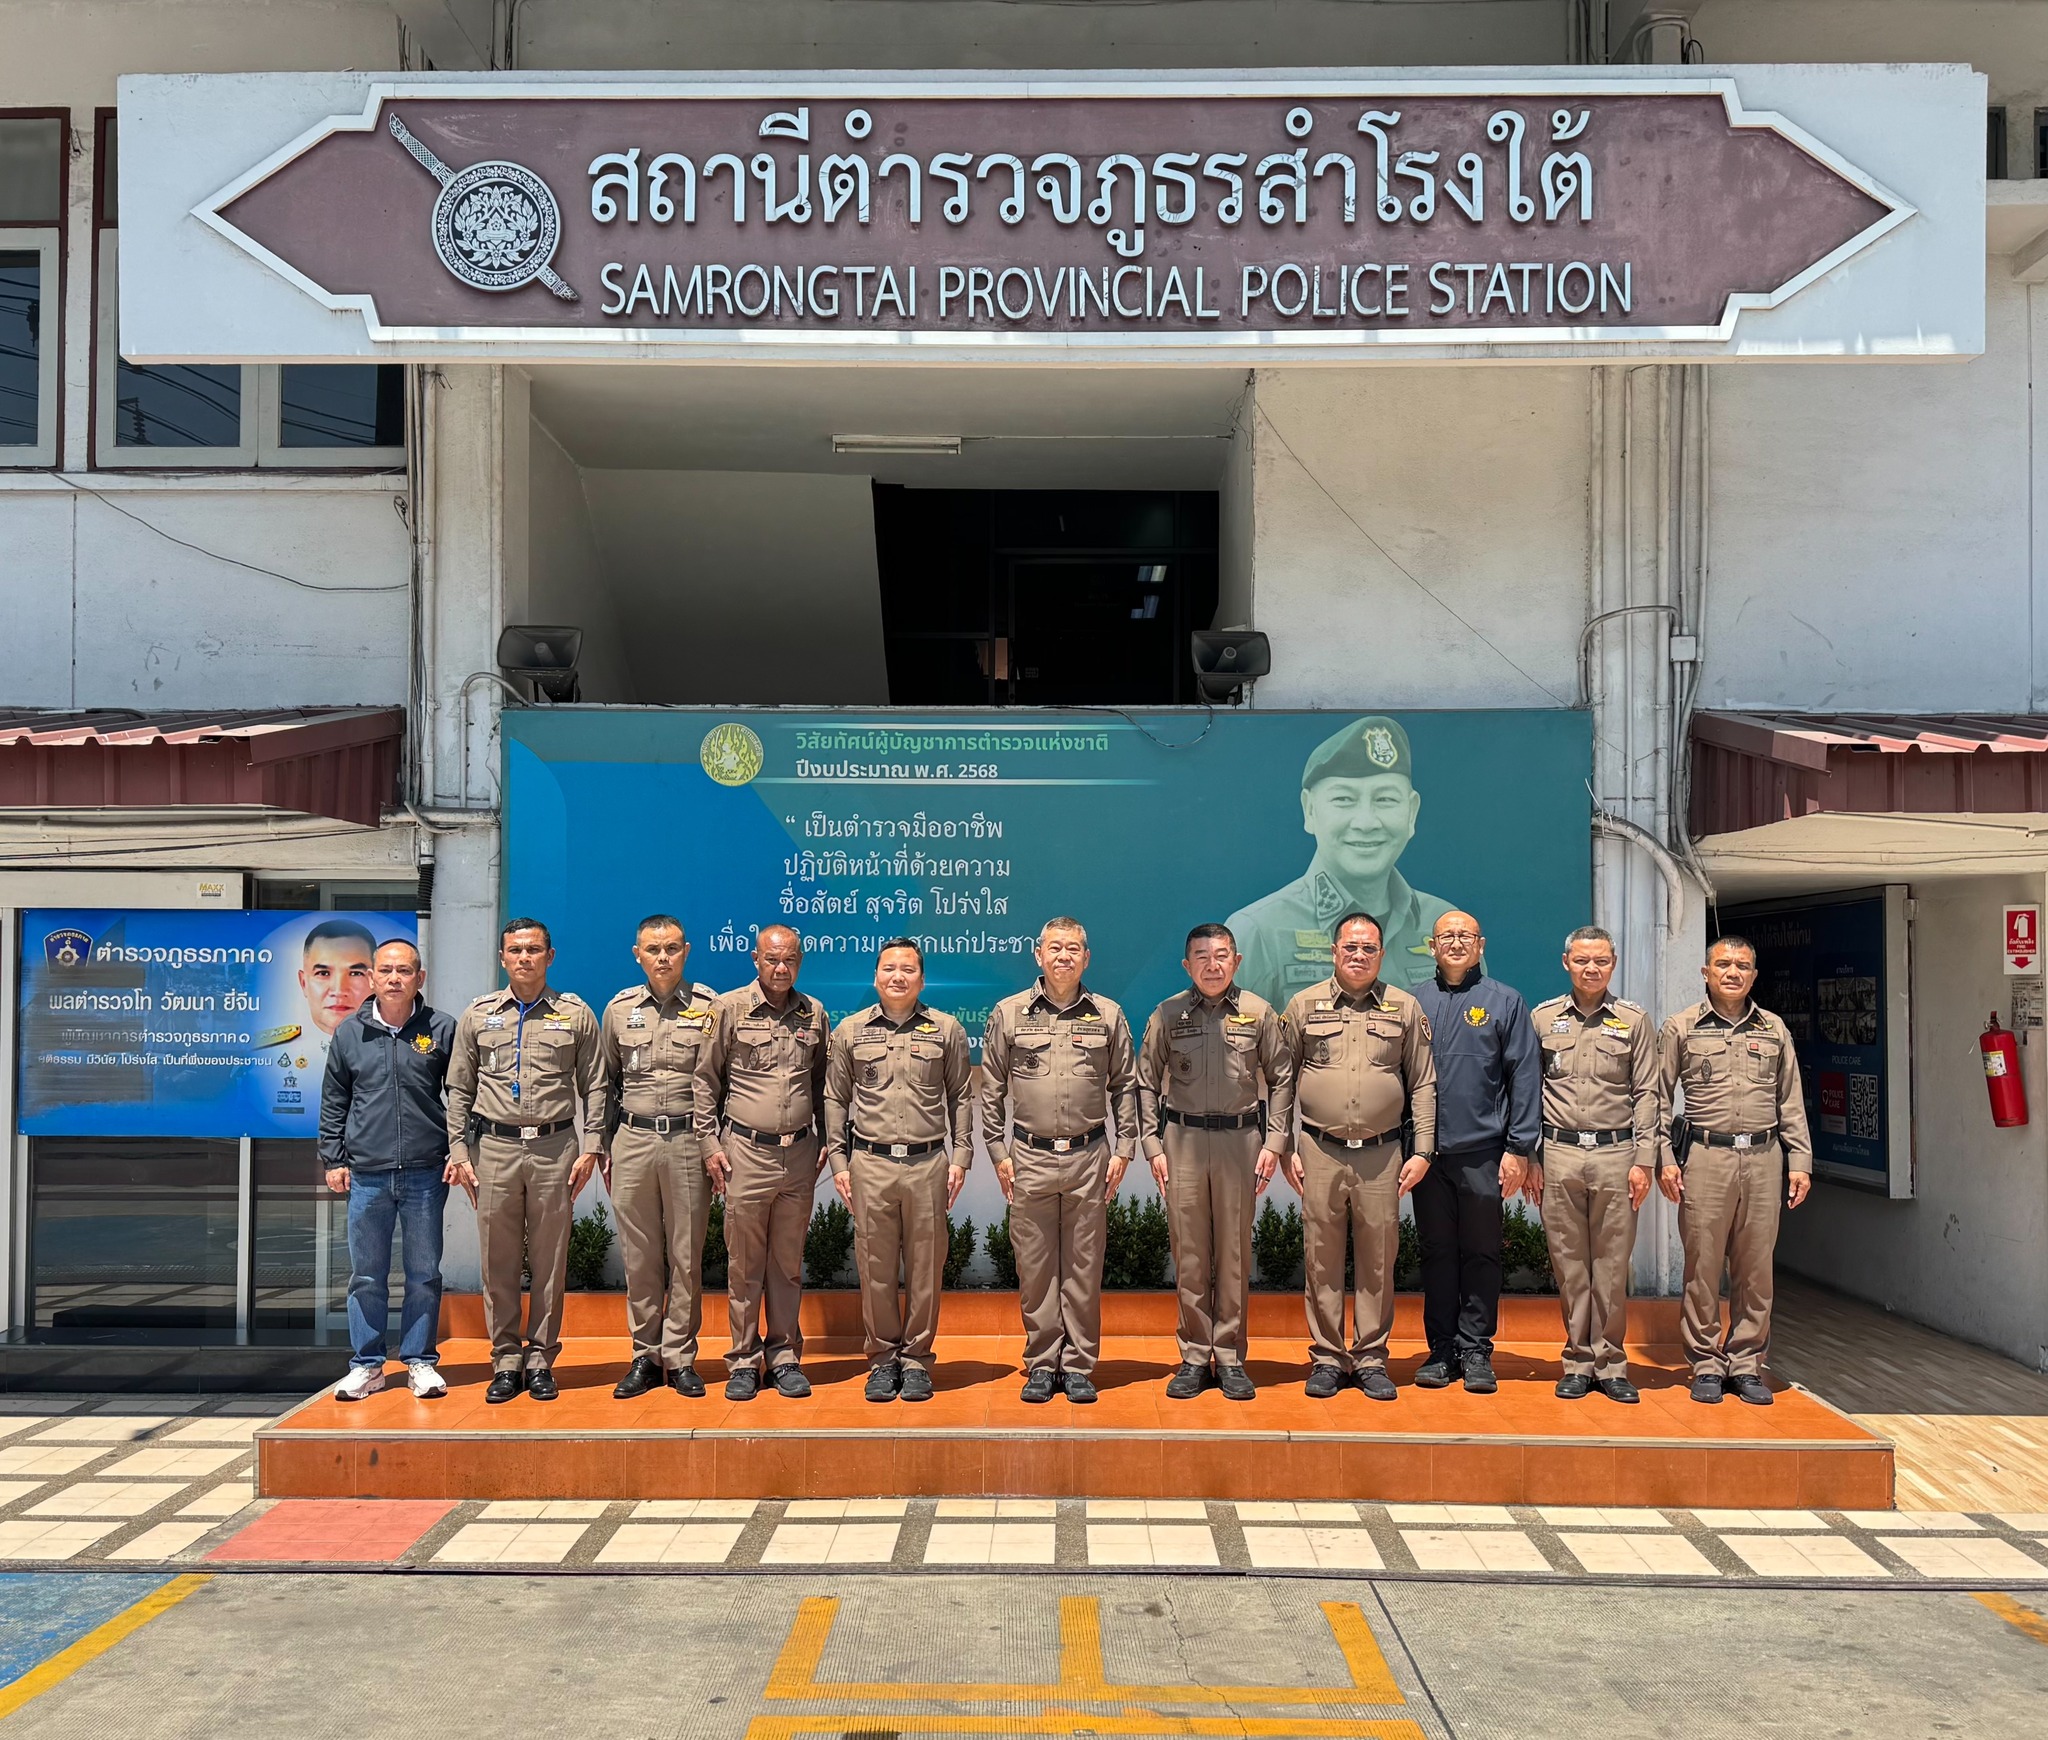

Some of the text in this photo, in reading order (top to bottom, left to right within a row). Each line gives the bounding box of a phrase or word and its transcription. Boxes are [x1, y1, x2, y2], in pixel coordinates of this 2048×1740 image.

[588, 107, 1594, 258] สถานีตำรวจภูธรสำโรงใต้
[600, 261, 1633, 320] SAMRONGTAI PROVINCIAL POLICE STATION
[796, 731, 1108, 754] วิสัยทัศน์ผู้บัญชาการตำรวจแห่งชาติ
[796, 759, 998, 778] ปีงบประมาณ พ.ศ. 2568
[784, 843, 1010, 882] ปฏิบัติหน้าที่ด้วยความ
[779, 881, 1009, 922] ซื่อสัตย์ สุจริต โปร่งใส
[49, 988, 261, 1011] พลตำรวจโท วัฒนา ยี่จีน
[86, 1052, 116, 1065] มีวินัย
[121, 1052, 158, 1065] โปร่งใส
[1832, 1055, 1862, 1066] POLICE CARE
[1829, 1089, 1844, 1098] POLICE
